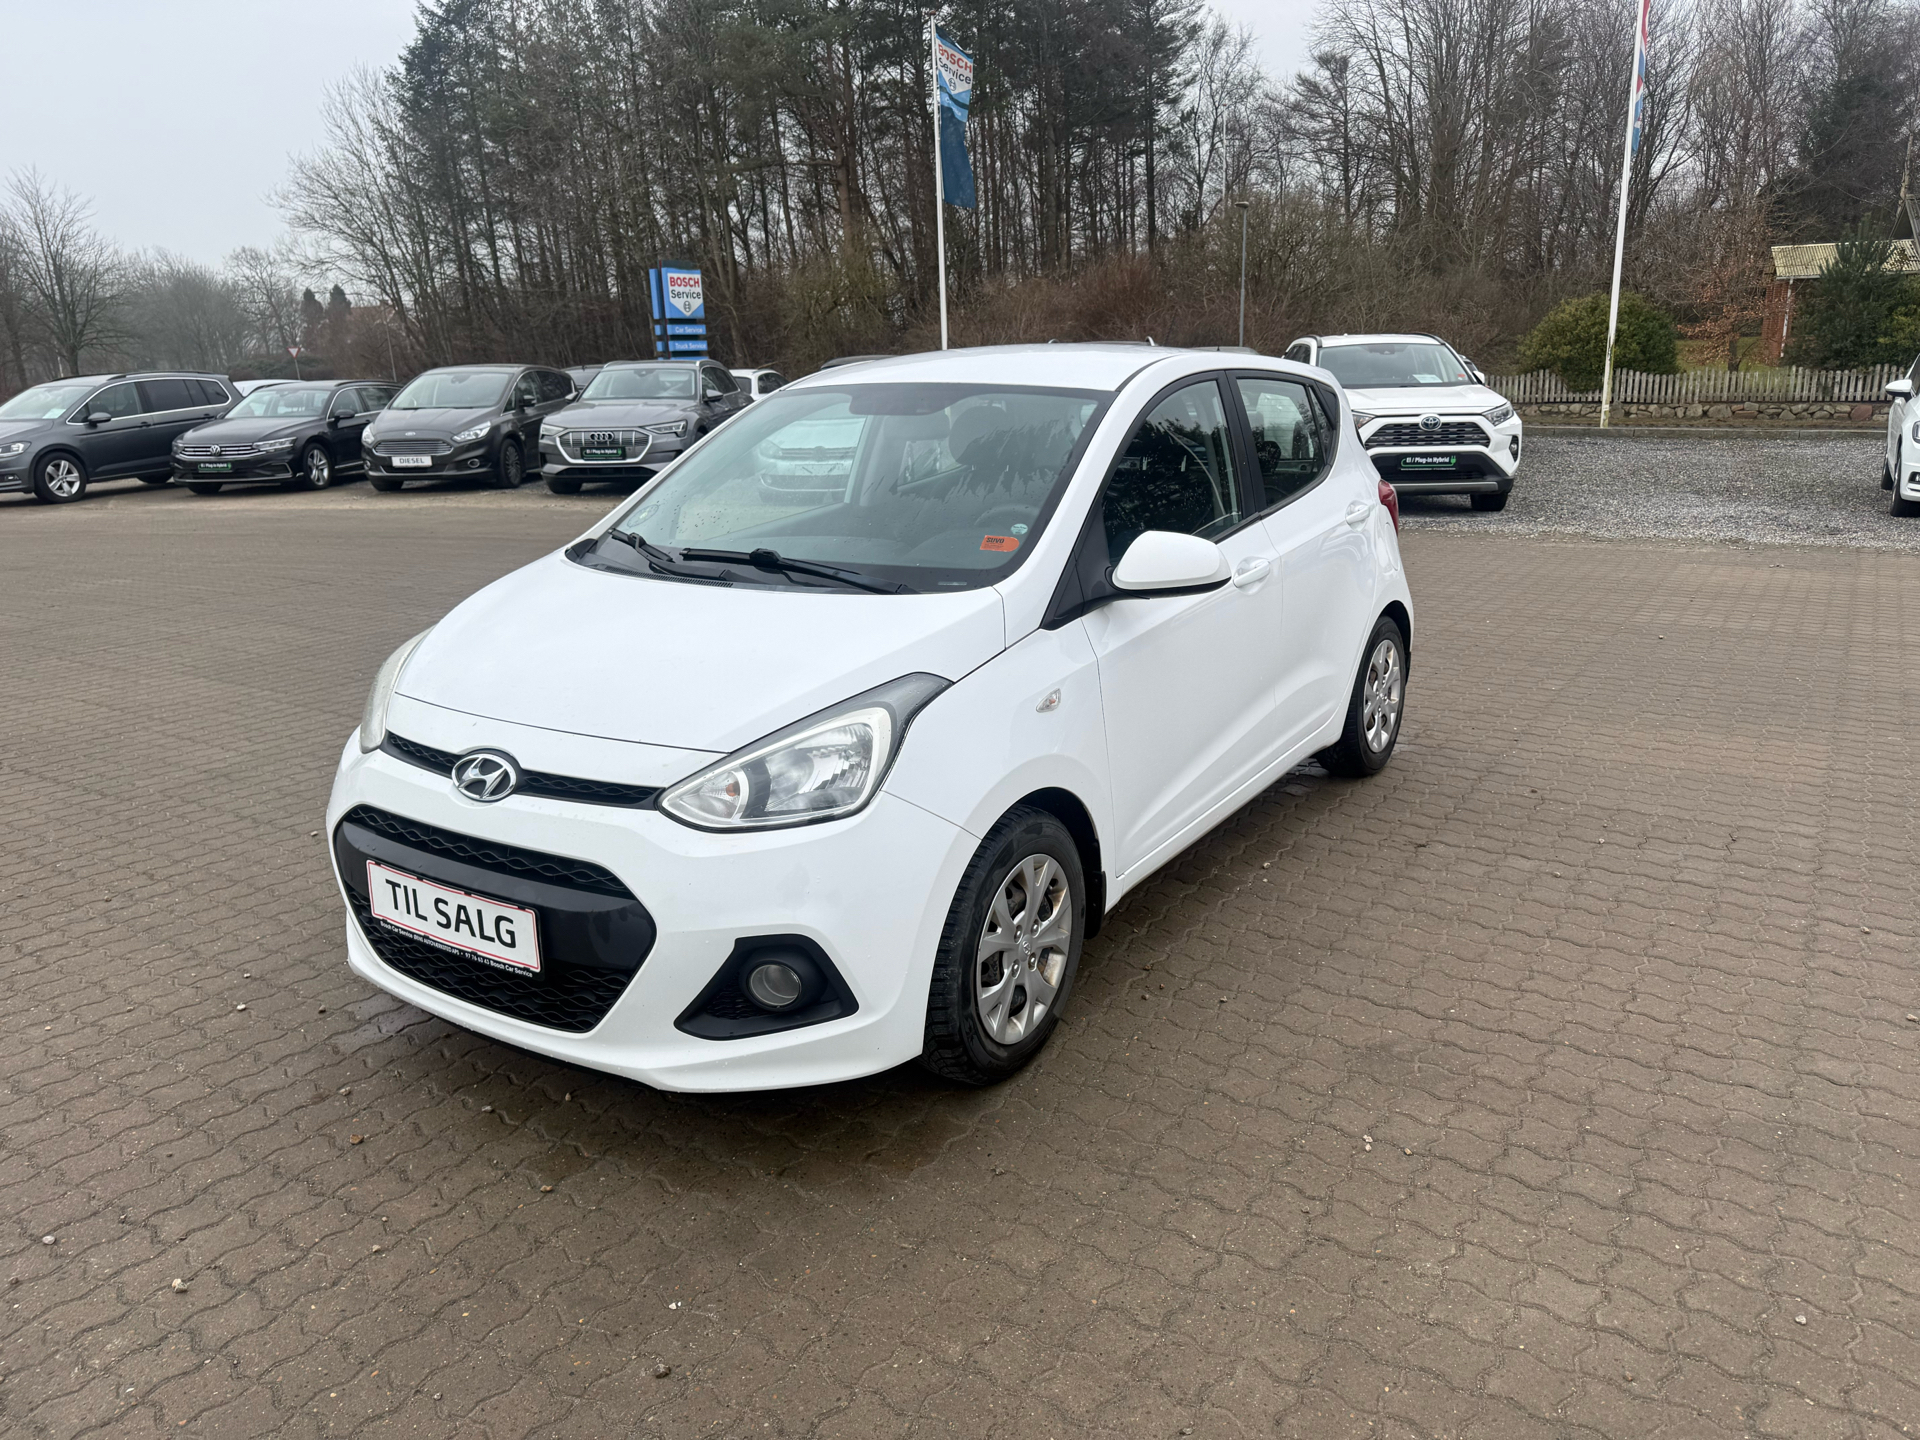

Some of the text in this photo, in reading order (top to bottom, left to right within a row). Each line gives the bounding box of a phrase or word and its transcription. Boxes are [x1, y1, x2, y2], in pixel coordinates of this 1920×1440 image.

[938, 44, 972, 73] BOSCH
[939, 57, 971, 85] Service
[670, 276, 700, 288] BOSCH
[671, 290, 701, 299] Service
[385, 878, 516, 948] TIL SALG
[380, 921, 391, 930] Bosch
[399, 928, 413, 939] Service
[490, 960, 504, 969] Bosch
[515, 968, 533, 977] Service
